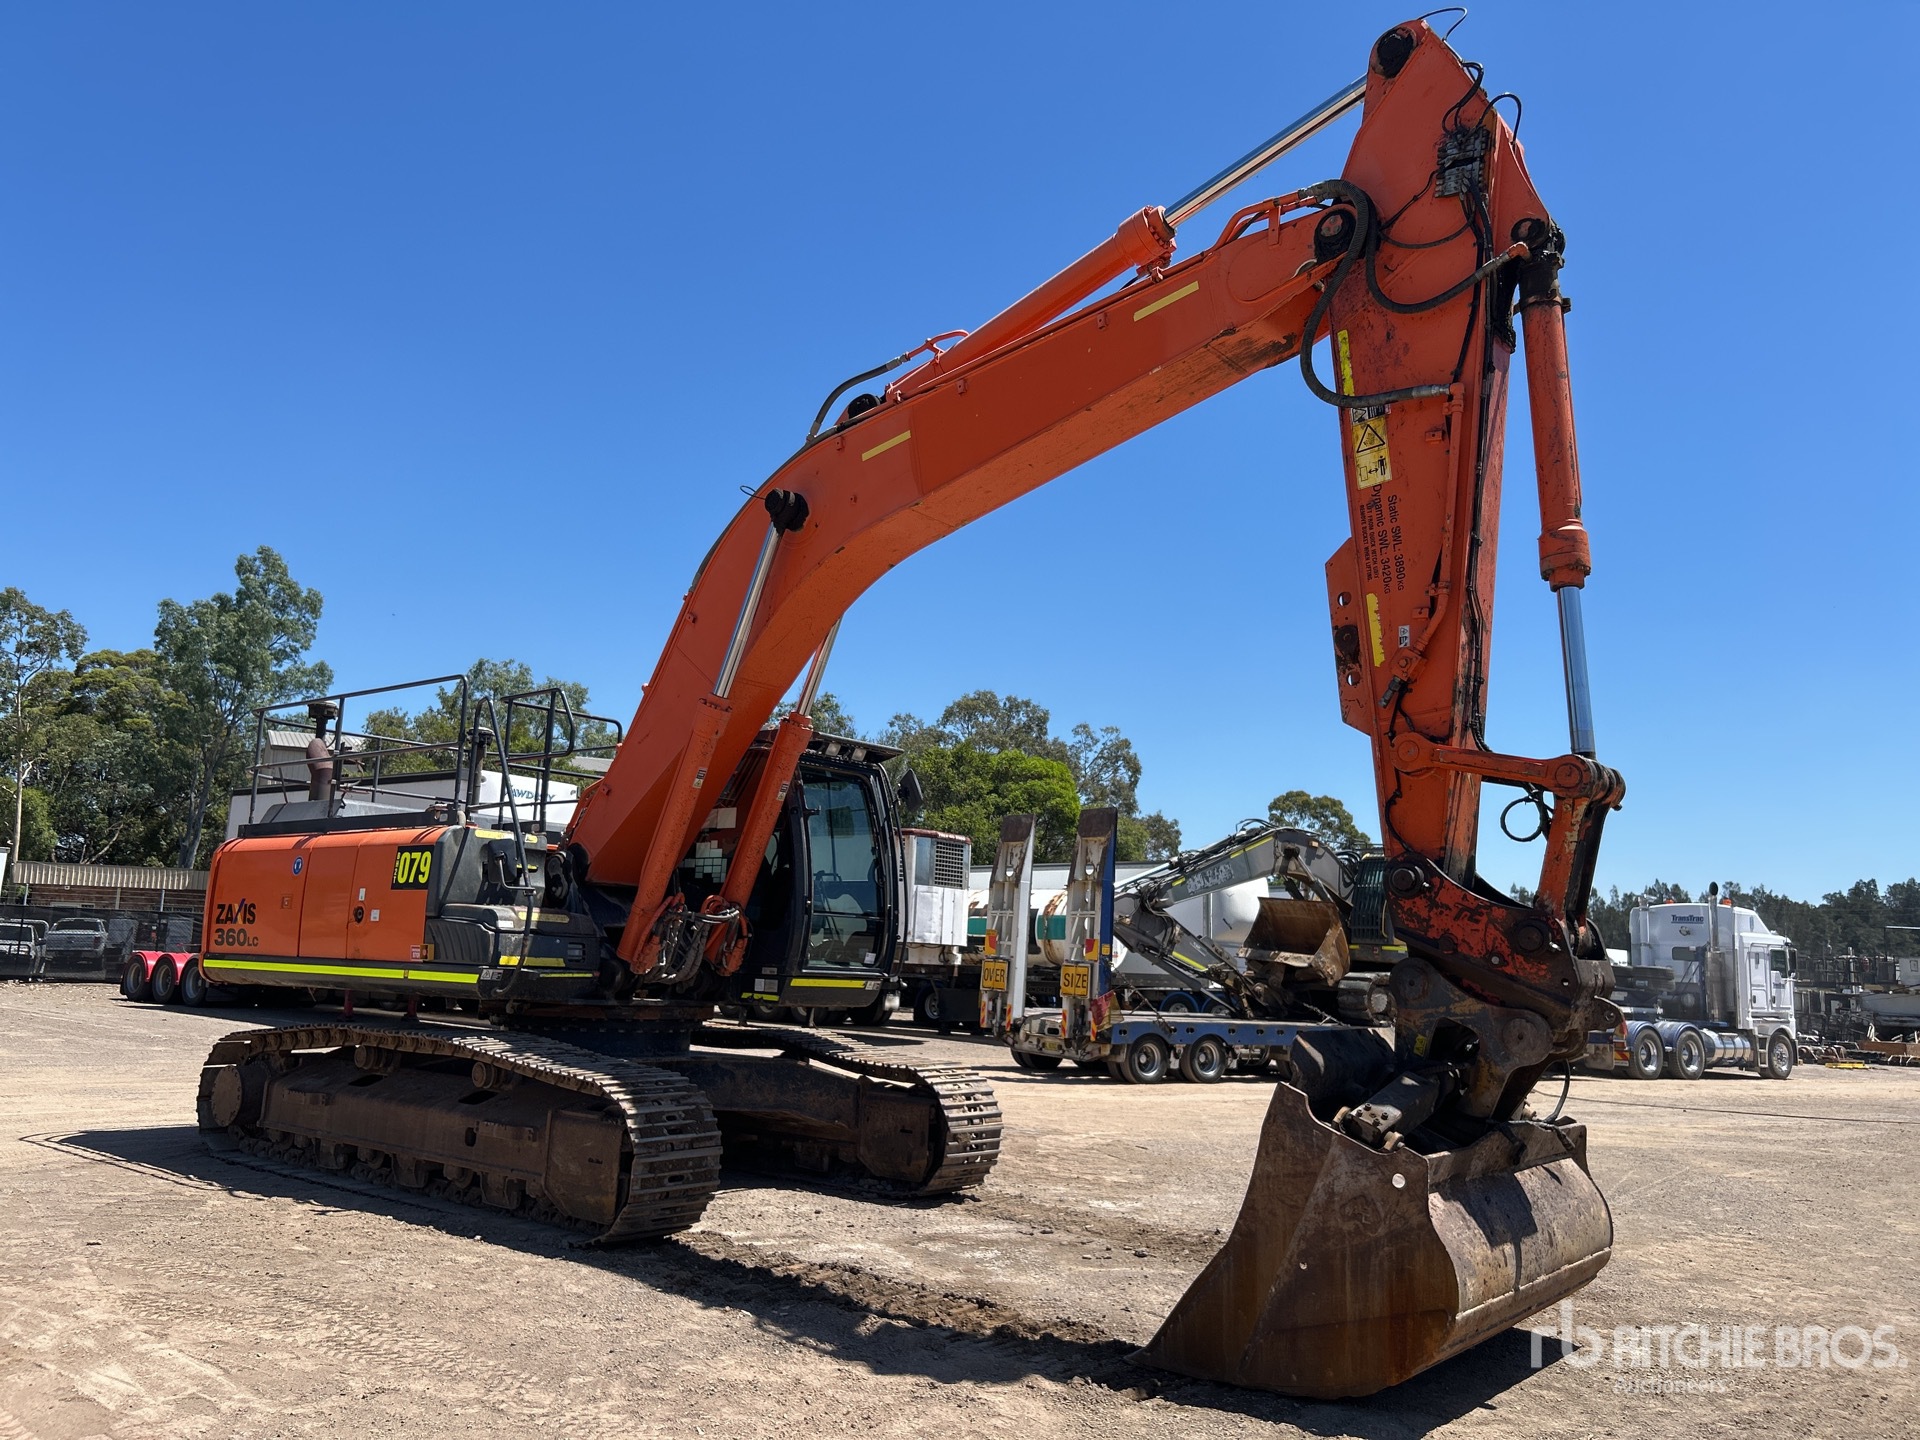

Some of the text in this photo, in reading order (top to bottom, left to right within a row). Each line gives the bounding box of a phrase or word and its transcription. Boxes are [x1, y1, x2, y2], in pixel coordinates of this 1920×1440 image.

[1371, 484, 1385, 527] Dynamic
[1378, 530, 1389, 556] SWL:
[1388, 494, 1399, 523] Static
[1391, 525, 1402, 552] SWL:
[397, 851, 432, 884] 079
[215, 898, 257, 925] ZAXIS
[1671, 914, 1704, 923] TransTrac
[984, 967, 1005, 983] OVER
[1063, 973, 1087, 988] SIZE
